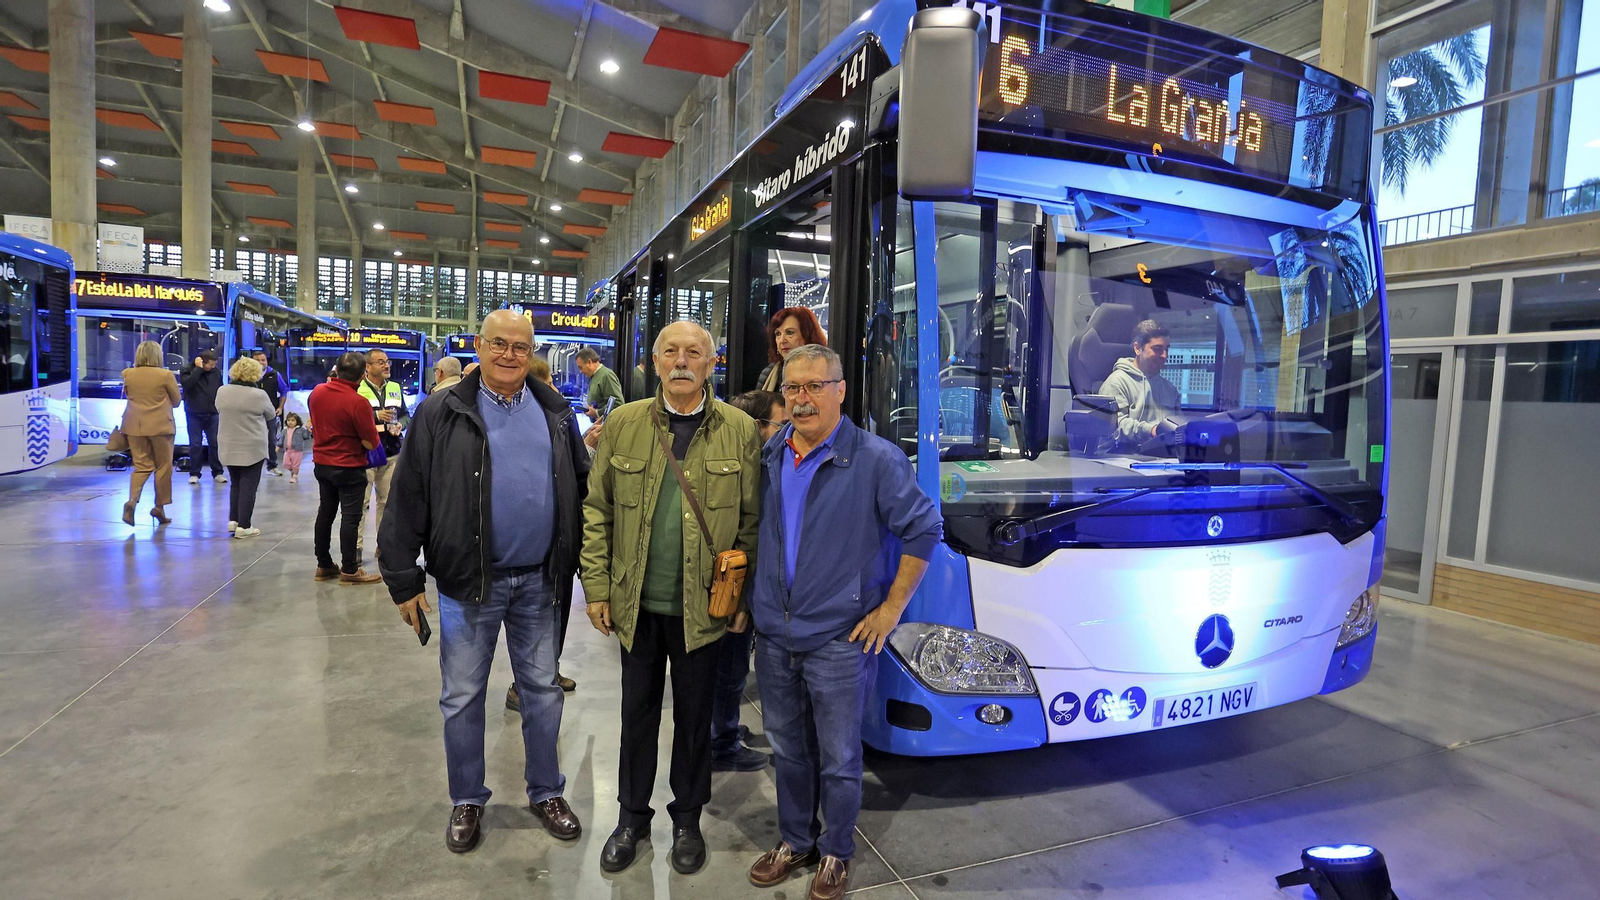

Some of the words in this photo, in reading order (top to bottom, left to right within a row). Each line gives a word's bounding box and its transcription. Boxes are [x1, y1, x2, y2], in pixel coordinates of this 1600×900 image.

[840, 45, 867, 97] 141
[999, 35, 1030, 106] 6
[1106, 63, 1149, 129] La
[1159, 76, 1262, 152] Granja
[754, 168, 790, 208] Citaro
[793, 124, 850, 184] híbrido
[9, 222, 49, 234] IFECA
[705, 194, 729, 231] Granja
[103, 231, 138, 241] IFECA
[86, 281, 133, 298] Estella
[133, 284, 154, 299] Del
[1263, 615, 1303, 628] CITARO
[1167, 694, 1213, 721] 4821
[1220, 687, 1253, 713] NGV
